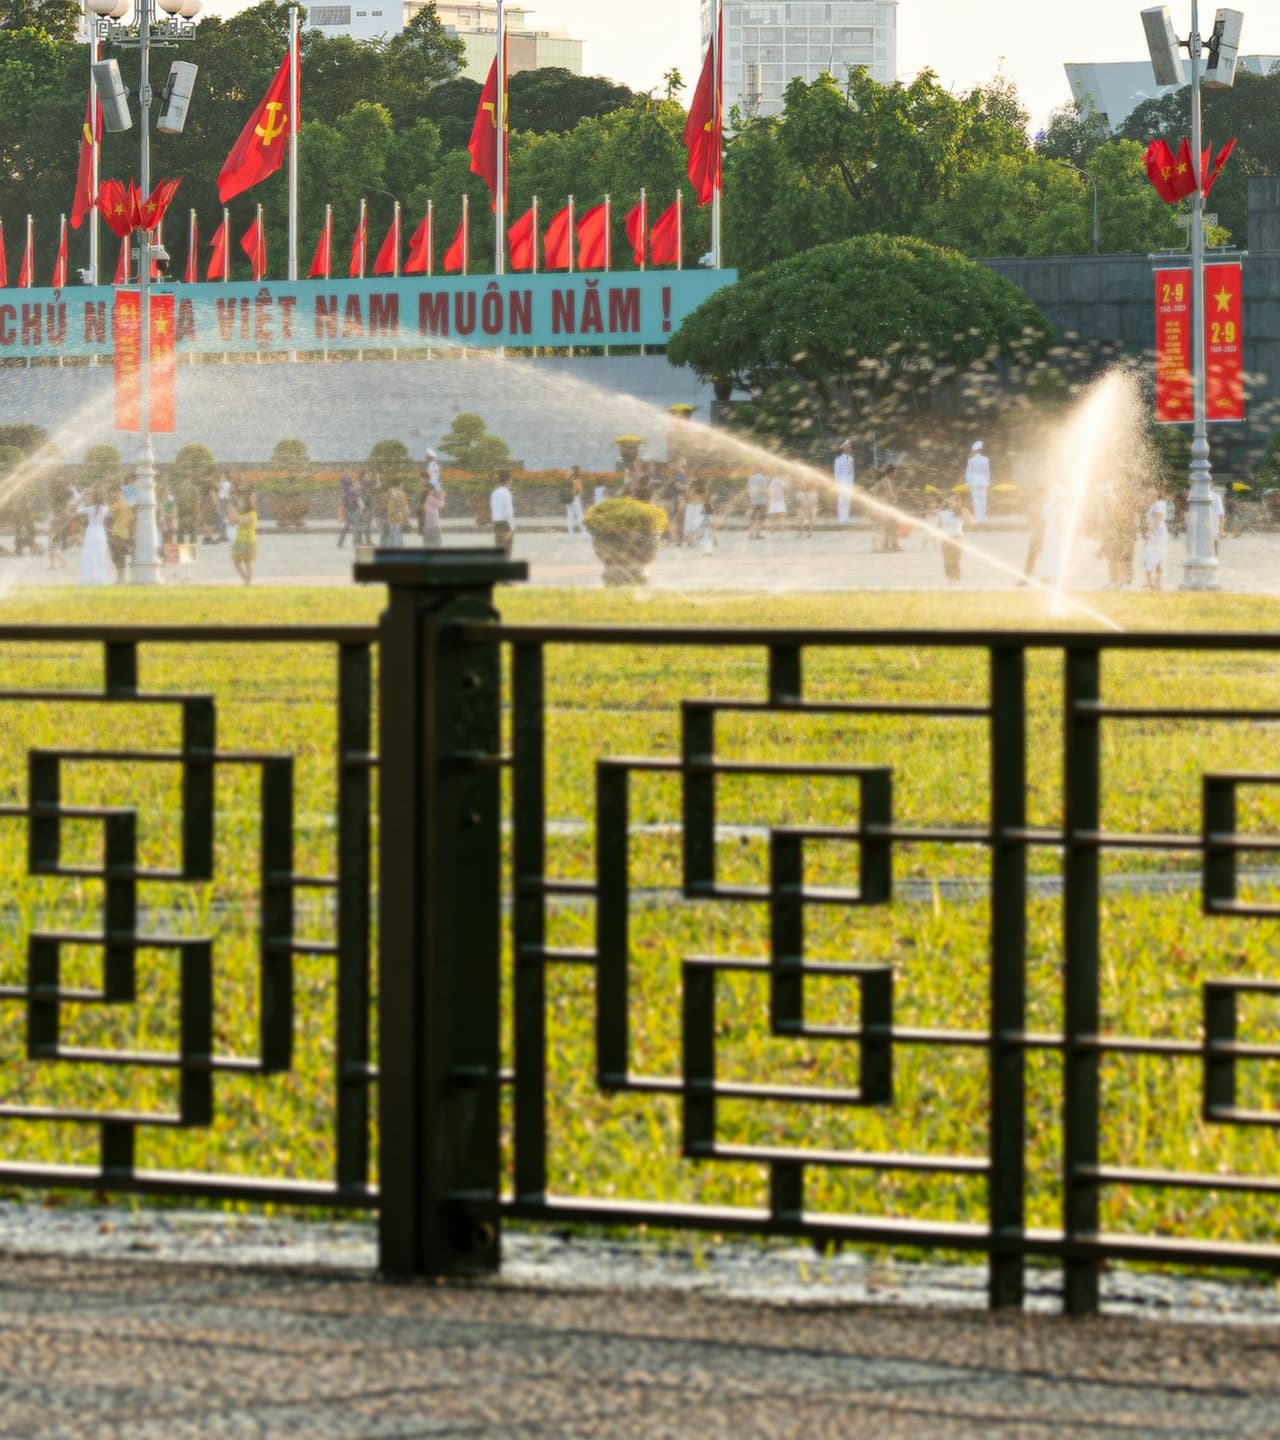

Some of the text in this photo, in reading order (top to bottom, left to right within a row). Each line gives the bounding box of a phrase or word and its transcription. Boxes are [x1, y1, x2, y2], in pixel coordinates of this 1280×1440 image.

[0, 289, 67, 346] CHỦ
[215, 287, 297, 349] VIỆT
[314, 293, 400, 338] NAM
[418, 281, 533, 337] MUÔN
[551, 278, 641, 334] NĂM
